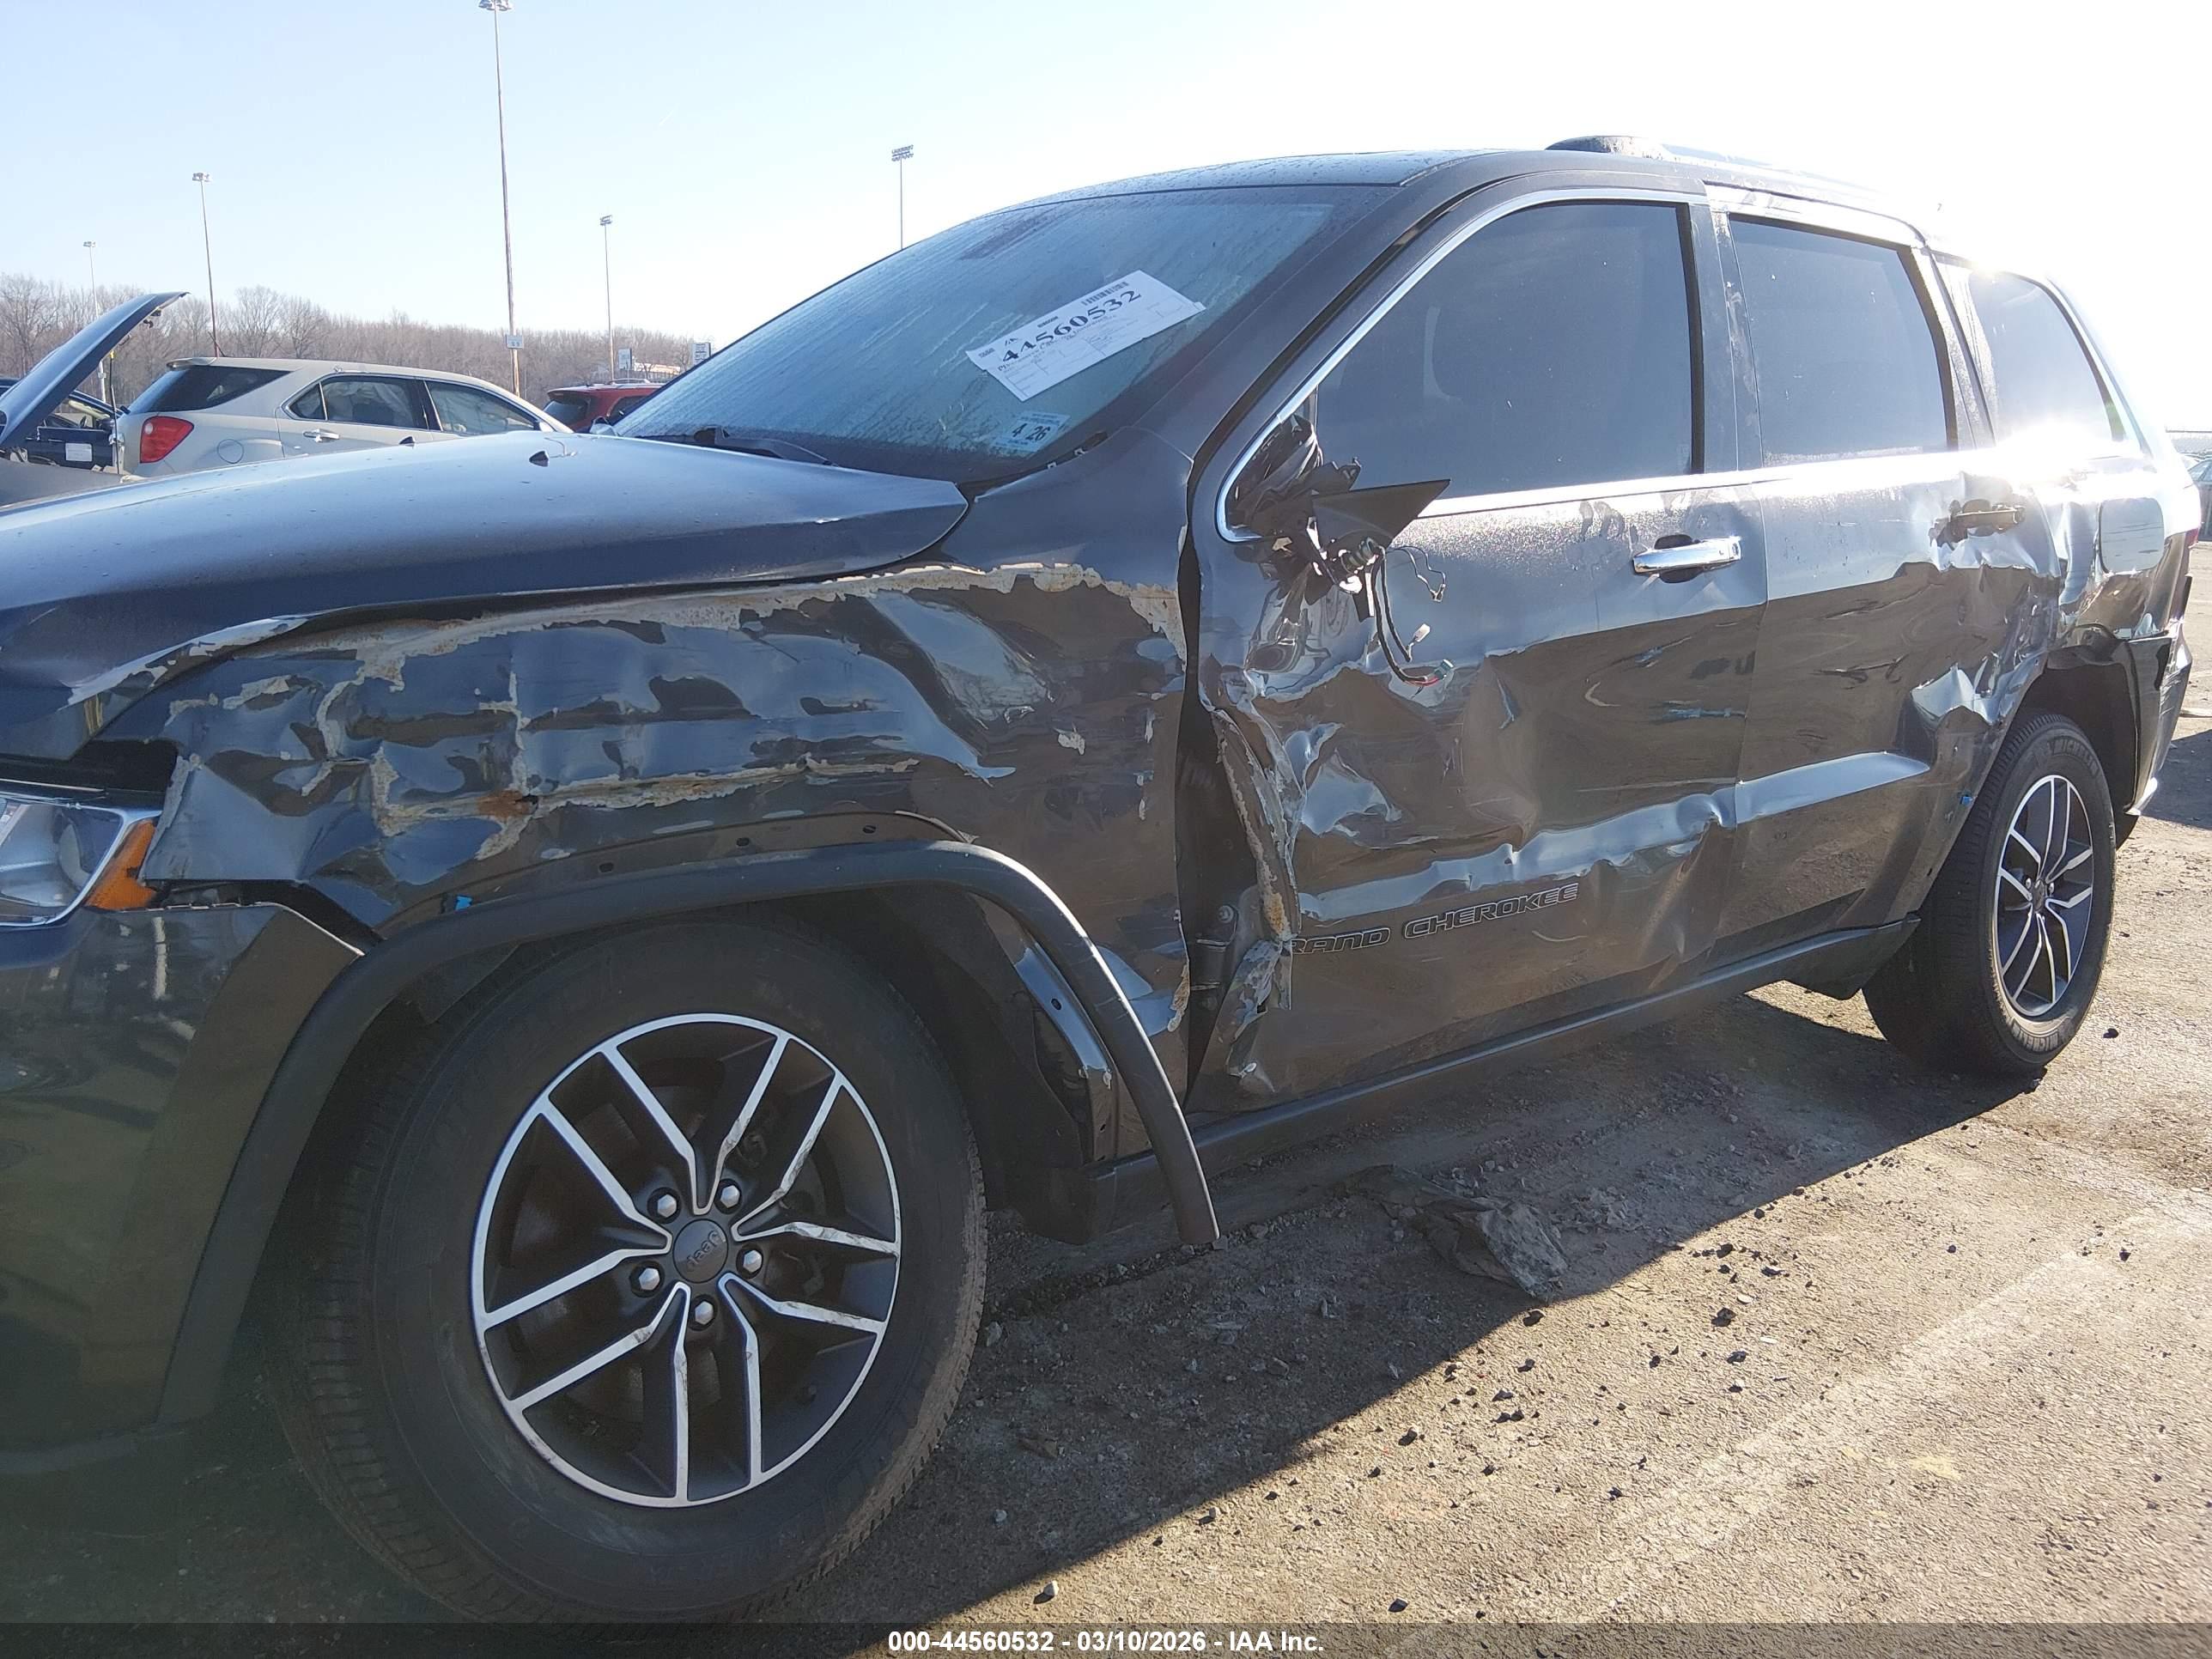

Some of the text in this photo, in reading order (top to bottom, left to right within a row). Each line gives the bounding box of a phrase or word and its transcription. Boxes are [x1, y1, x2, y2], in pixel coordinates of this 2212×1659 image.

[1025, 425, 1051, 442] 26
[1291, 882, 1580, 955] RAND CHEROKEE
